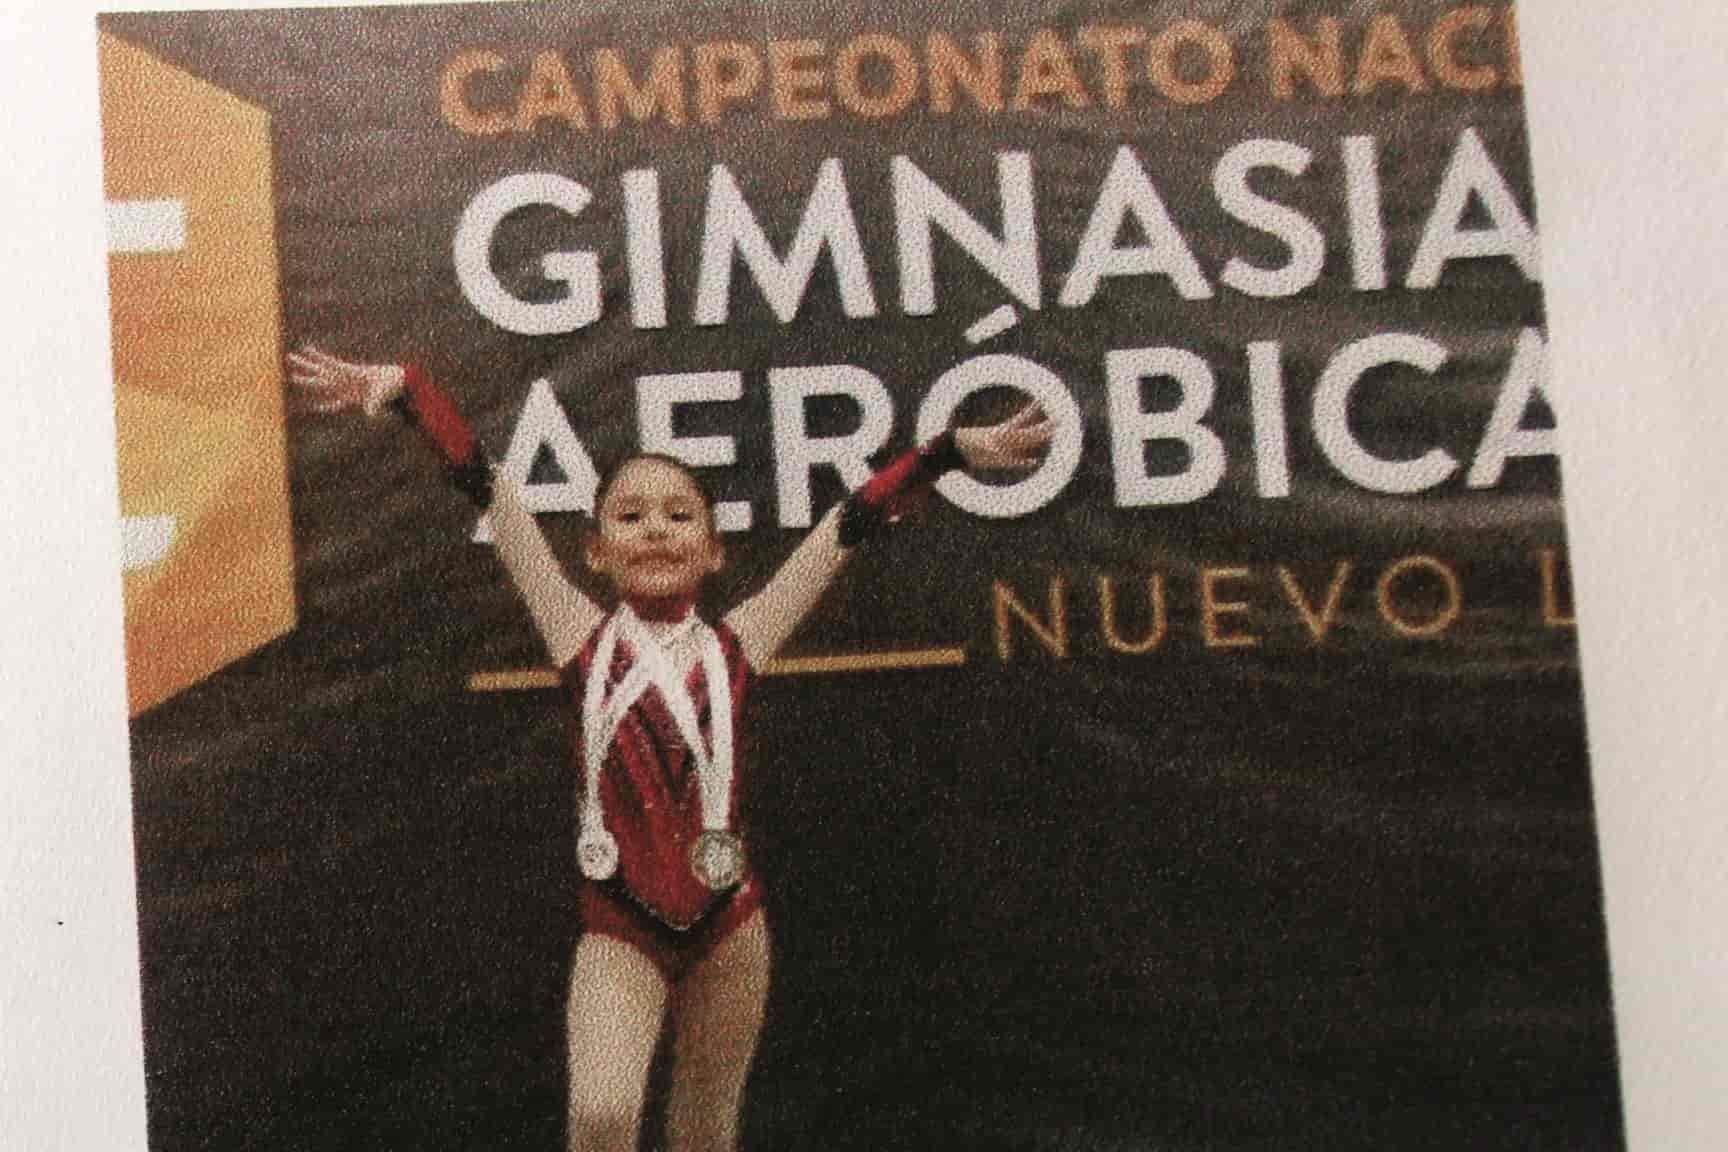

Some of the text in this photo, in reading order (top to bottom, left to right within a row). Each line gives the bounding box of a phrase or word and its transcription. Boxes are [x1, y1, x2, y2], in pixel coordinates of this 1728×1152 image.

[439, 16, 1238, 138] CAMPEONATO
[453, 126, 1542, 336] GIMNASIA
[471, 304, 1560, 544] AERÓBICA
[992, 552, 1465, 671] NUEVO
